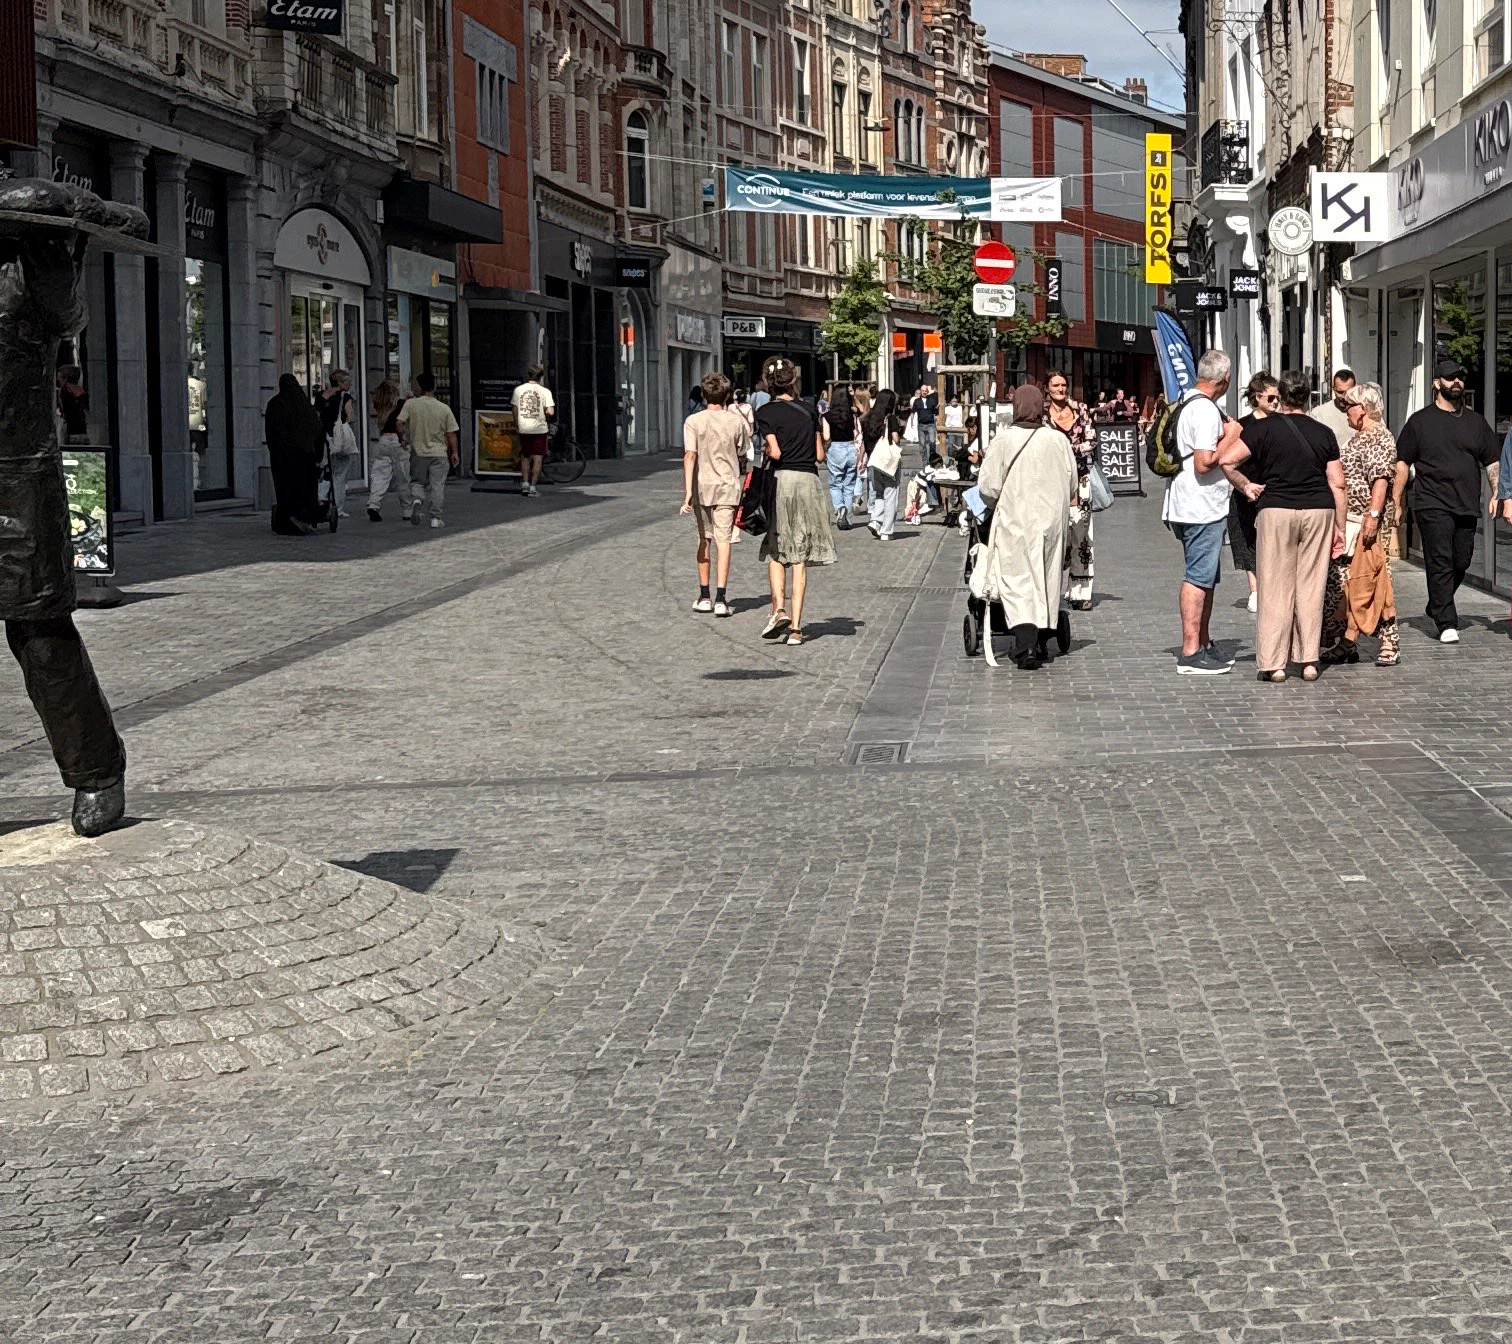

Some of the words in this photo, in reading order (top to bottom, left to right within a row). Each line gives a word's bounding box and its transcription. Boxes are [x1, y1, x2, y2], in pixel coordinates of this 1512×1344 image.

[1475, 100, 1512, 168] KIKO
[737, 184, 790, 197] CONTINUE
[847, 191, 880, 201] platform
[886, 193, 906, 201] voor
[184, 189, 216, 229] Etam
[1150, 172, 1168, 267] TORFS
[1048, 267, 1059, 302] INNO
[1232, 276, 1257, 285] JACK
[1232, 284, 1259, 293] JONE
[732, 322, 757, 333] P&B
[1100, 430, 1134, 442] SALE
[1101, 442, 1134, 454] SALE
[1101, 454, 1135, 466] SALE
[1102, 466, 1136, 478] SALE
